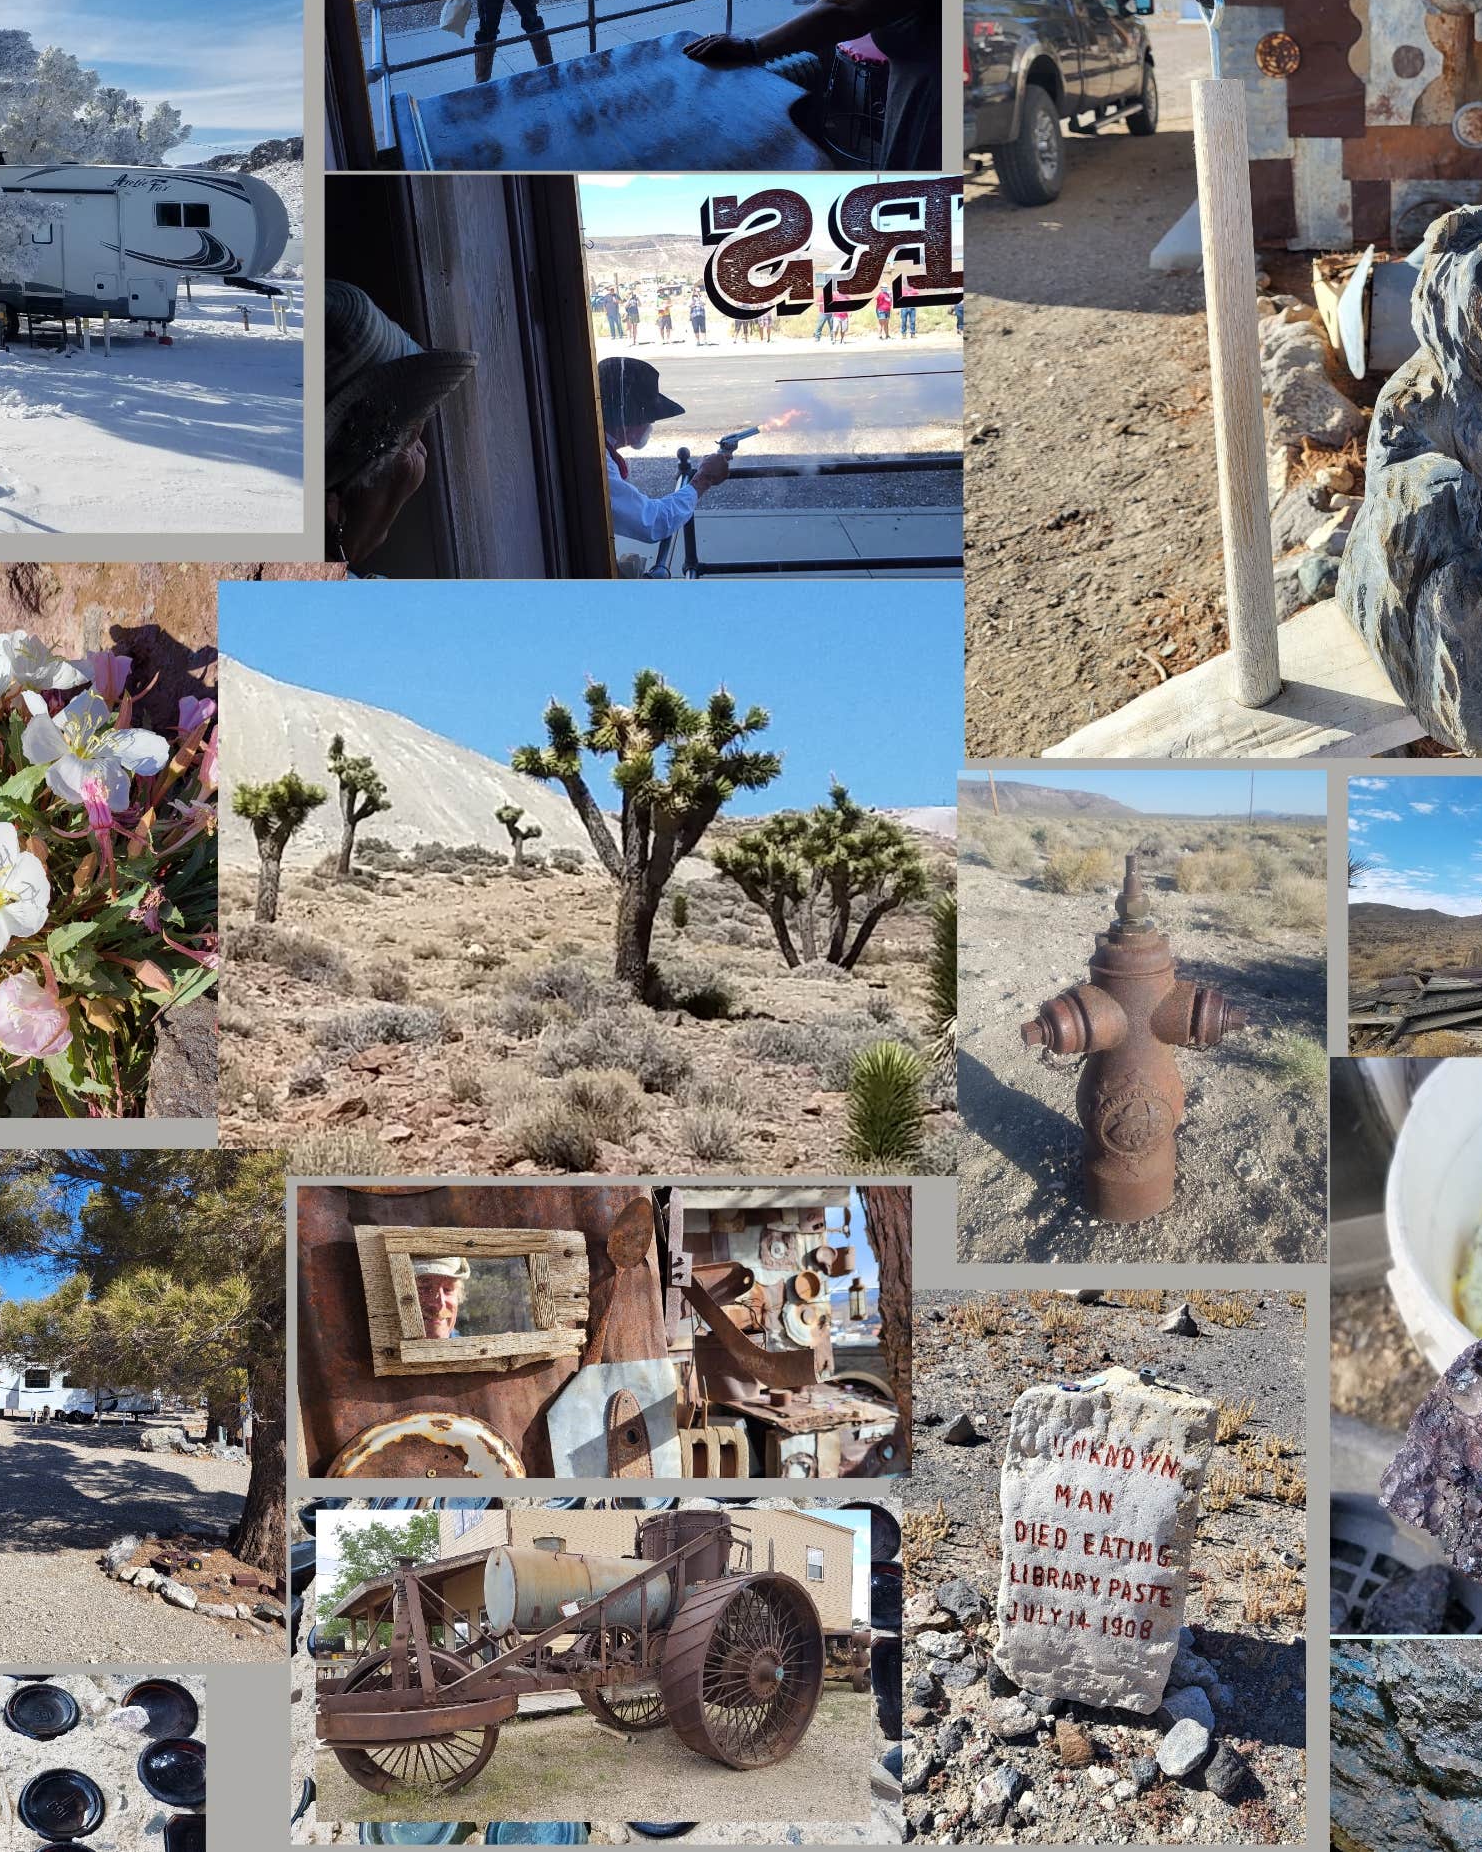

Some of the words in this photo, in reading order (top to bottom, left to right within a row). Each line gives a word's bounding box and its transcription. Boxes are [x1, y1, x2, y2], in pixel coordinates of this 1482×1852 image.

[147, 178, 171, 193] Fox
[1053, 1435, 1181, 1479] UNKNOWN
[1054, 1484, 1115, 1514] MAN
[1015, 1520, 1068, 1553] DIED
[1084, 1532, 1172, 1569] EATING
[1009, 1561, 1102, 1596] LIBRARY
[1108, 1578, 1172, 1609] PASTE
[1005, 1601, 1062, 1625] JULY
[1066, 1609, 1092, 1630] 14
[1102, 1617, 1155, 1641] 1908
